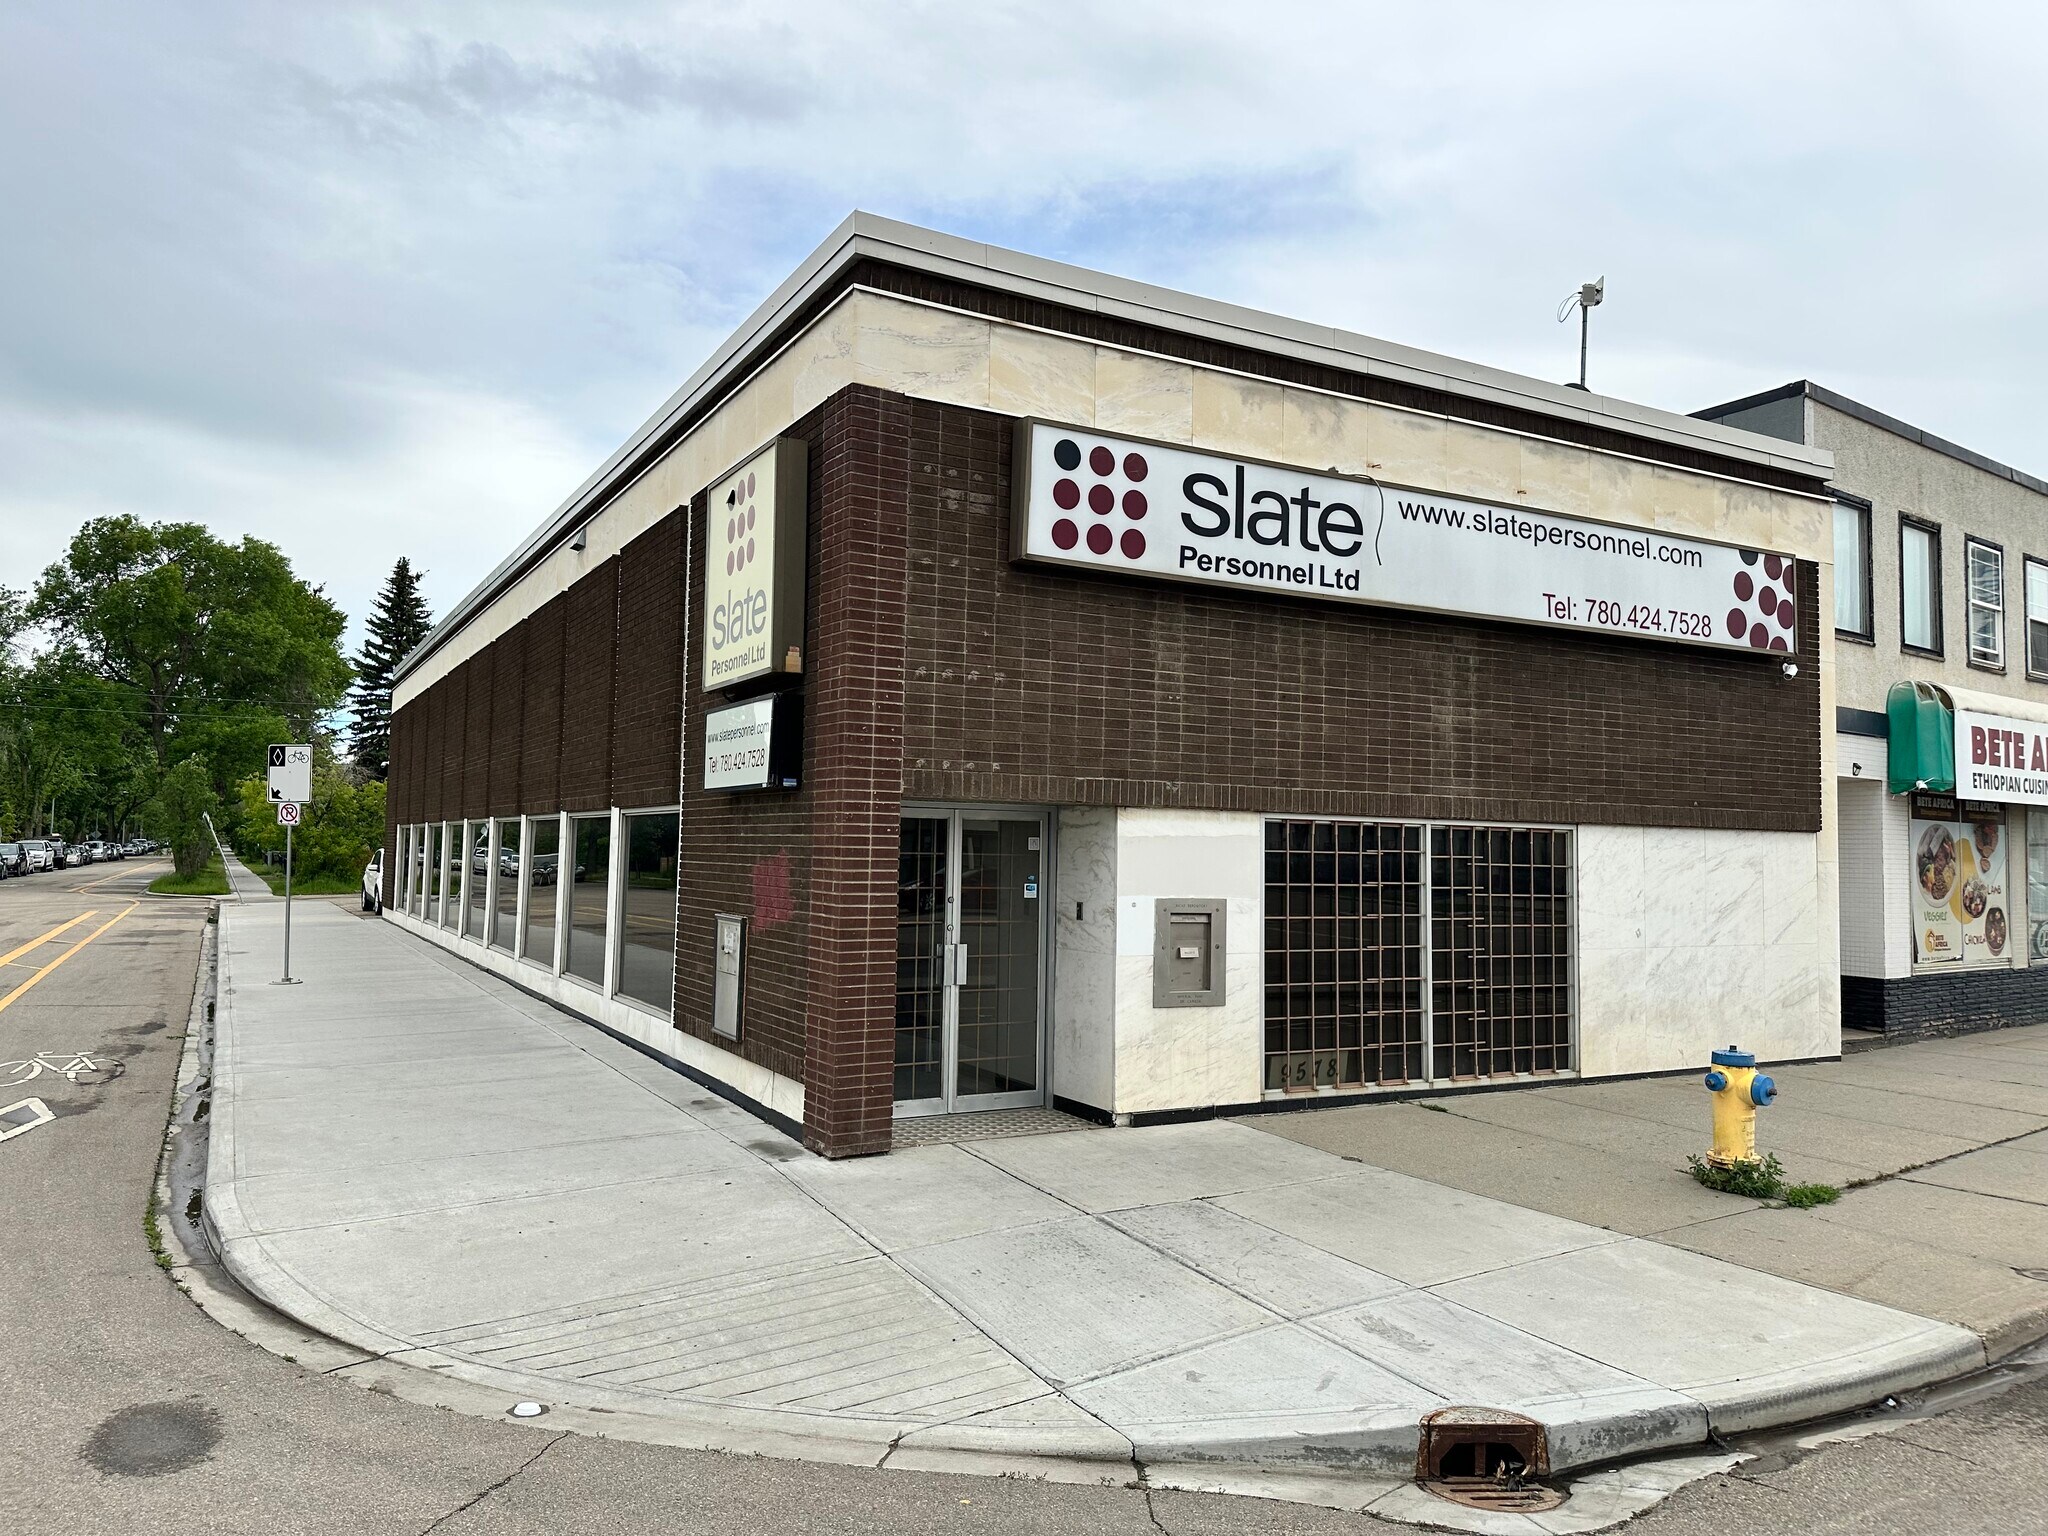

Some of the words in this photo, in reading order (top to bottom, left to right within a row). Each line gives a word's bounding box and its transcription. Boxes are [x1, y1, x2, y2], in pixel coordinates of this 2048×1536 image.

[1397, 500, 1702, 568] www.slatepersonnel.com
[1179, 545, 1314, 586] Personnel
[1319, 564, 1360, 592] Ltd
[1542, 592, 1578, 621] Tel:
[1585, 598, 1712, 638] 780.424.7528
[711, 646, 751, 677] Personnel
[751, 641, 766, 664] Ltd
[707, 721, 769, 743] www.slatepersonnel.com
[1971, 725, 2025, 770] BETE
[2030, 734, 2048, 773] A
[720, 748, 766, 772] 780.424.7528
[1972, 772, 2021, 793] ETHIOPIAN
